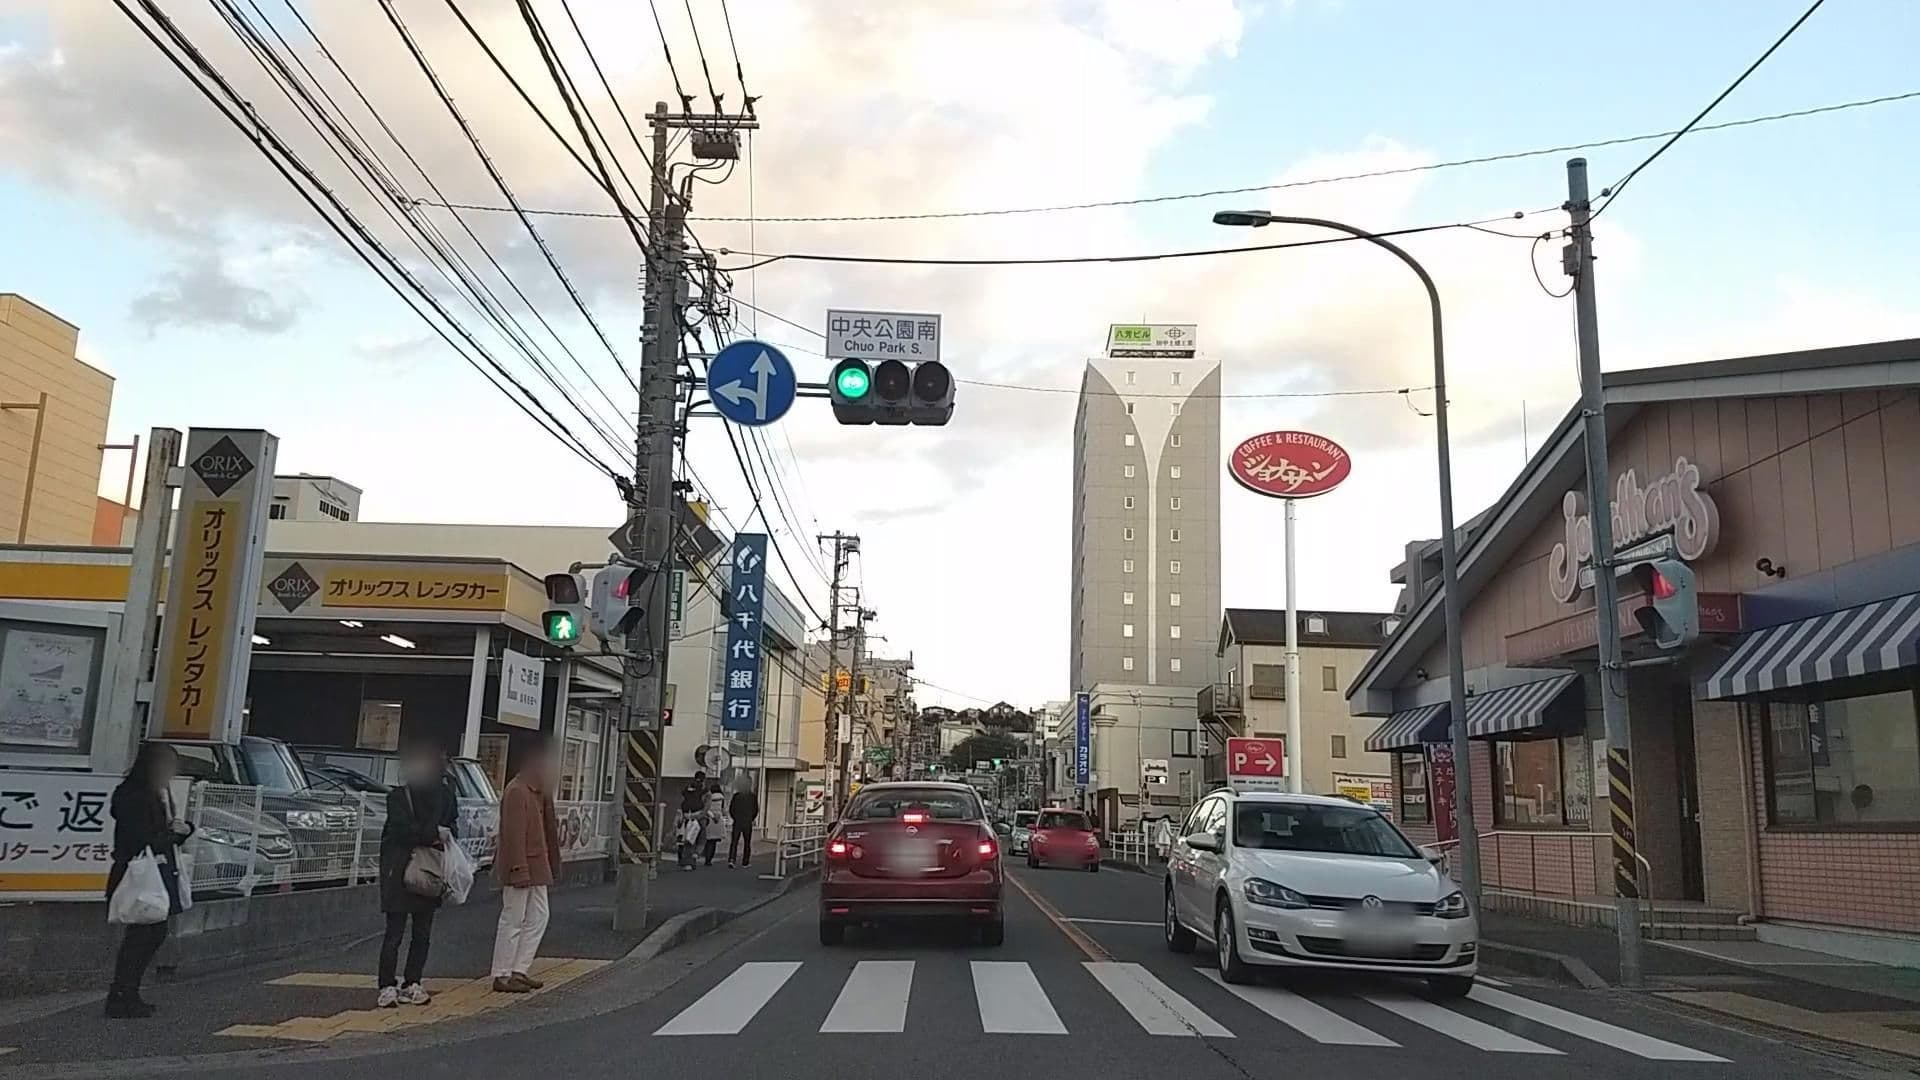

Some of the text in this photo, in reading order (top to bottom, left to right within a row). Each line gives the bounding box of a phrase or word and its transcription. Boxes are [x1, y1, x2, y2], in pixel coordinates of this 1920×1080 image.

[832, 316, 936, 341] 中央公園南
[844, 340, 922, 354] Chuo Park S.
[1239, 433, 1345, 461] COFFEE & RESTAURANT
[200, 455, 244, 471] ORIX
[1242, 454, 1339, 492] ジョナサン
[274, 578, 311, 592] ORIX
[328, 578, 500, 600] オリックス レンタカー
[180, 508, 226, 726] オリックス レンタカー
[727, 584, 758, 718] 八千代銀行
[1235, 752, 1247, 772] P
[1435, 767, 1447, 806] ステーキ
